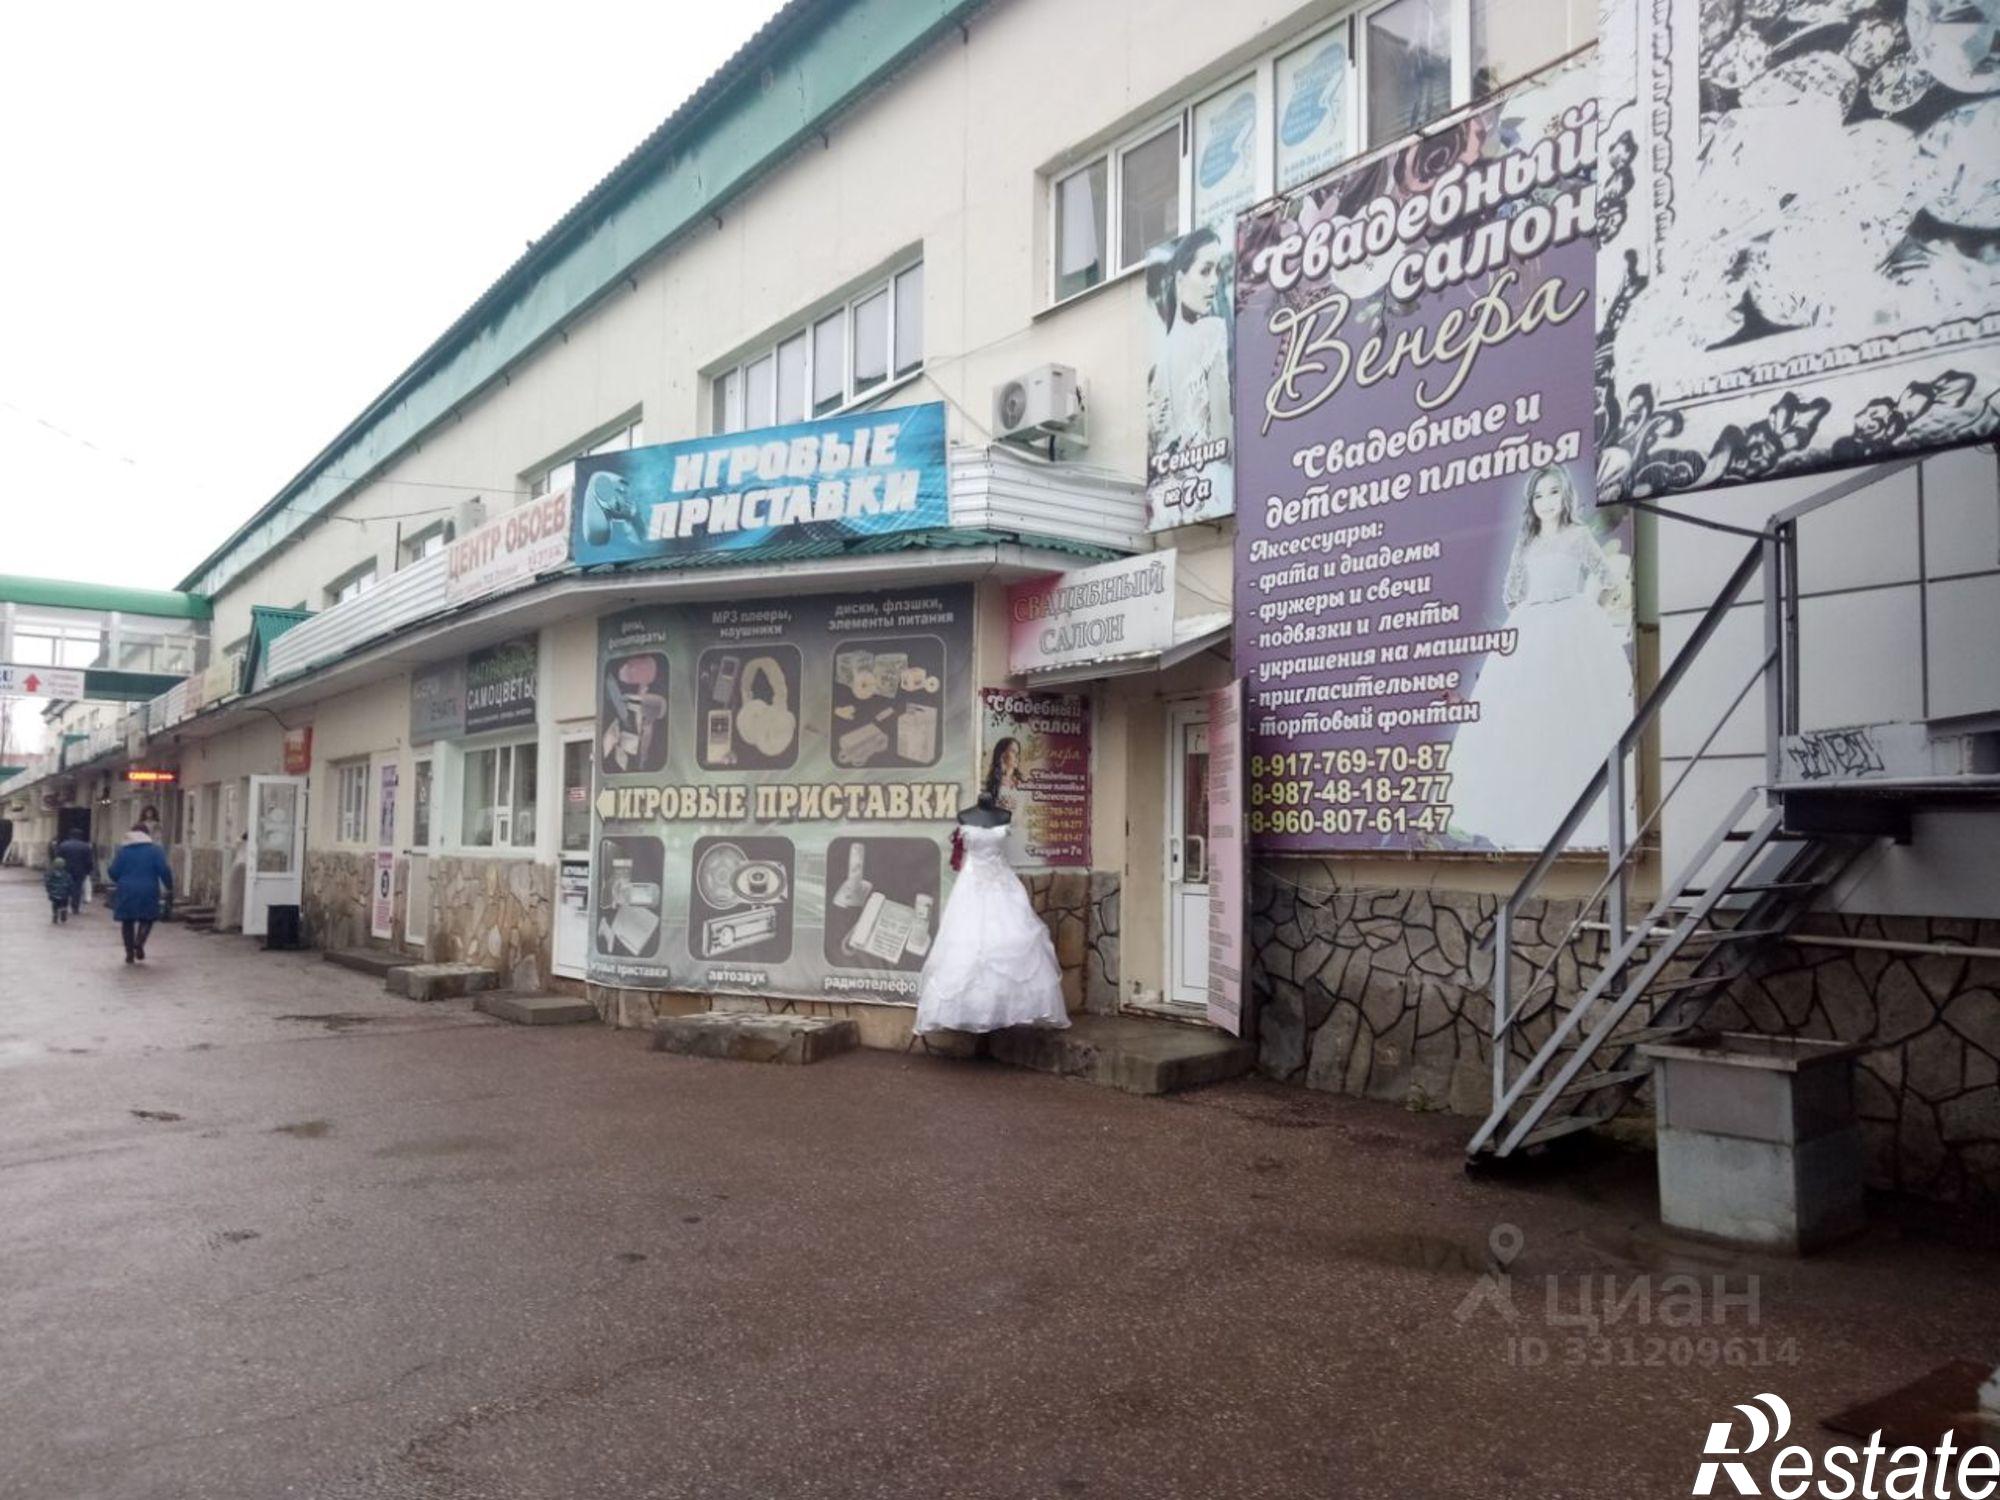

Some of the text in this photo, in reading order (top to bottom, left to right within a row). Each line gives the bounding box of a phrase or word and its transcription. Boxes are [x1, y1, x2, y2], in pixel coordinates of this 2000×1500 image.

[1252, 99, 1598, 291] Свадебный
[1389, 184, 1598, 301] салон
[1261, 270, 1588, 436] Венера
[1151, 438, 1227, 476] Секция
[1291, 393, 1541, 480] Свадебные и
[671, 423, 900, 493] ИГРОВЫЕ
[1265, 430, 1582, 530] детские платья
[647, 469, 921, 541] ПРИСТАВКИ
[449, 524, 501, 583] ЦЕНТР
[505, 493, 566, 553] ОБОЕВ
[1250, 520, 1384, 562] Аксессуары:
[1258, 540, 1441, 594] фата и диадемы
[834, 602, 879, 617] диски,
[1013, 560, 1166, 623] СВАДЕБНЫЙ
[1258, 575, 1432, 623] фужеры и свечи
[720, 624, 783, 640] наушники
[827, 612, 954, 631] элементы питания
[1039, 614, 1126, 655] САЛОН
[1258, 601, 1460, 650] подвязки и ленты
[1258, 629, 1518, 683] украшения на машину
[986, 694, 1081, 718] Свадебный
[1258, 668, 1460, 711] пригласительные
[1031, 719, 1082, 735] салон
[1258, 705, 1374, 740] тортовый
[1377, 700, 1481, 733] фонтан
[1250, 744, 1452, 778] 8-917-769-70-87
[618, 783, 961, 821] ИГРОВЫЕ ПРИСТАВКИ
[1250, 774, 1453, 806] 8-987-48-18-277
[1250, 805, 1454, 835] 8-960-807-61-47
[708, 968, 766, 985] автозвук
